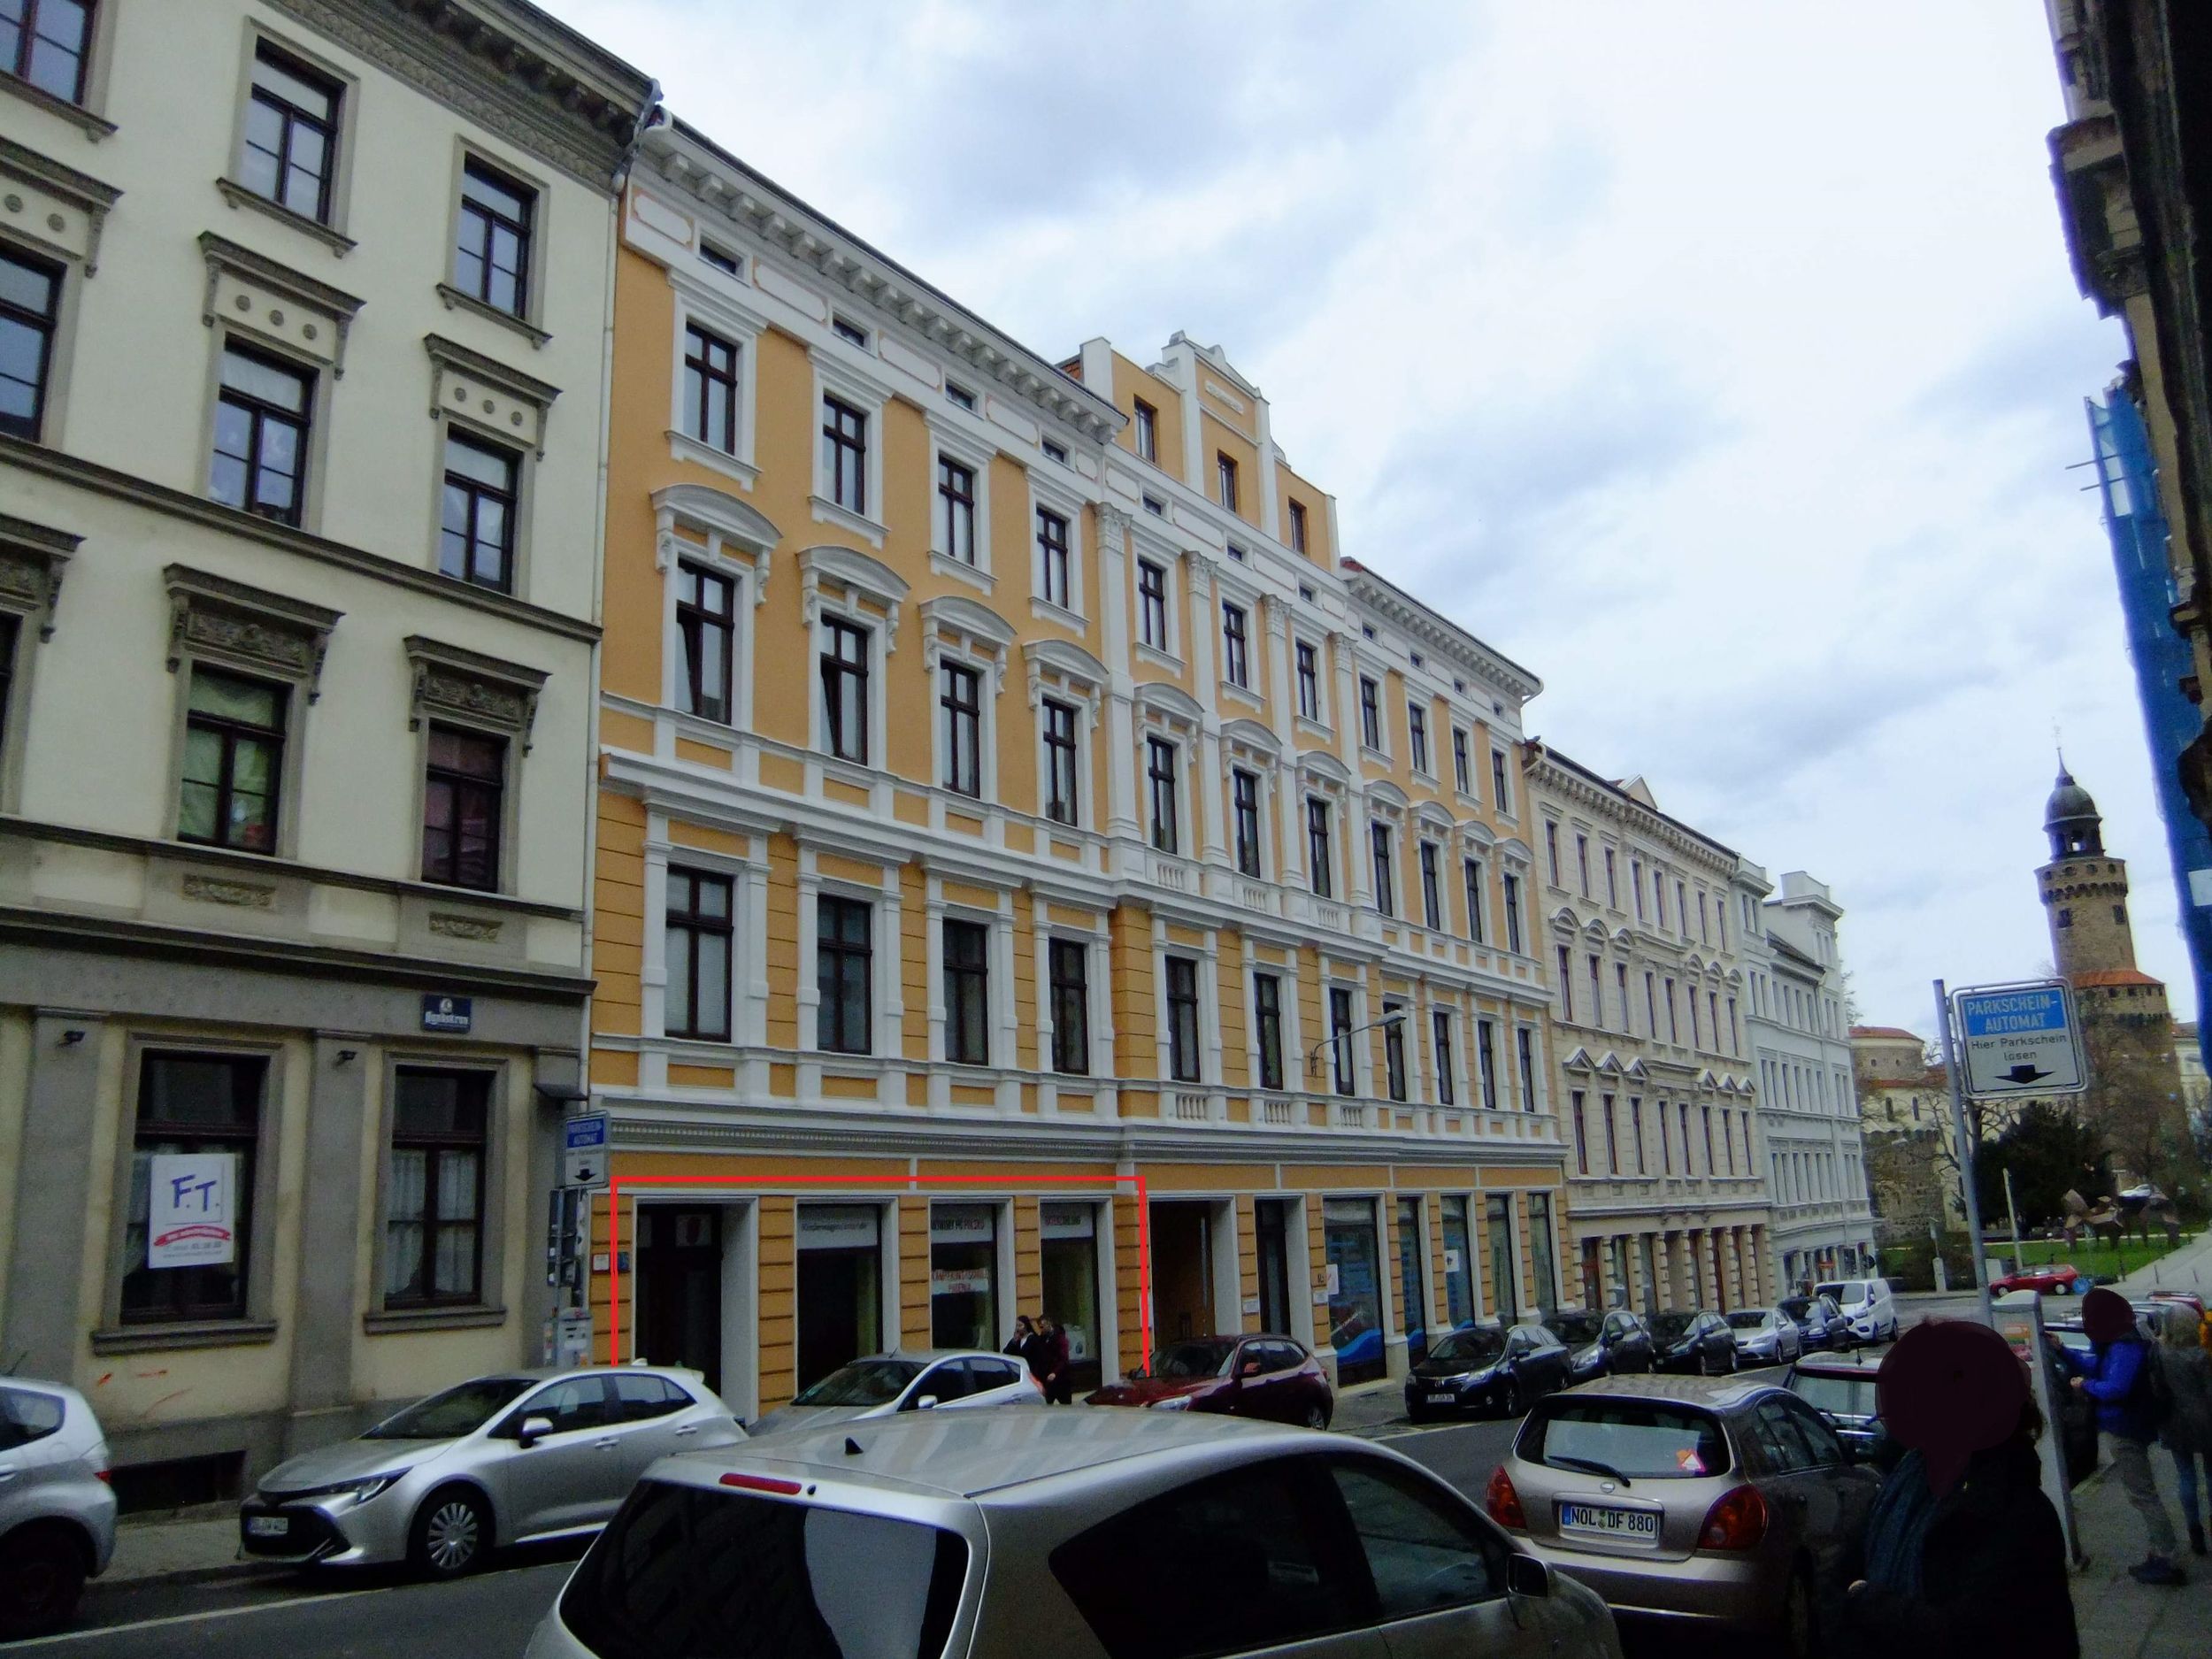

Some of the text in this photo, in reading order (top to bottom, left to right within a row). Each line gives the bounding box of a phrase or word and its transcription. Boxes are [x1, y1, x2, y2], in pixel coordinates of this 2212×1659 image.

[1967, 994, 2058, 1016] PARKSCHEIN-
[1985, 1013, 2046, 1033] AUTOMAT
[1971, 1033, 2068, 1050] Hier Parkschein
[171, 1173, 220, 1212] F.T.
[1571, 1507, 1655, 1532] NOL DF 880
